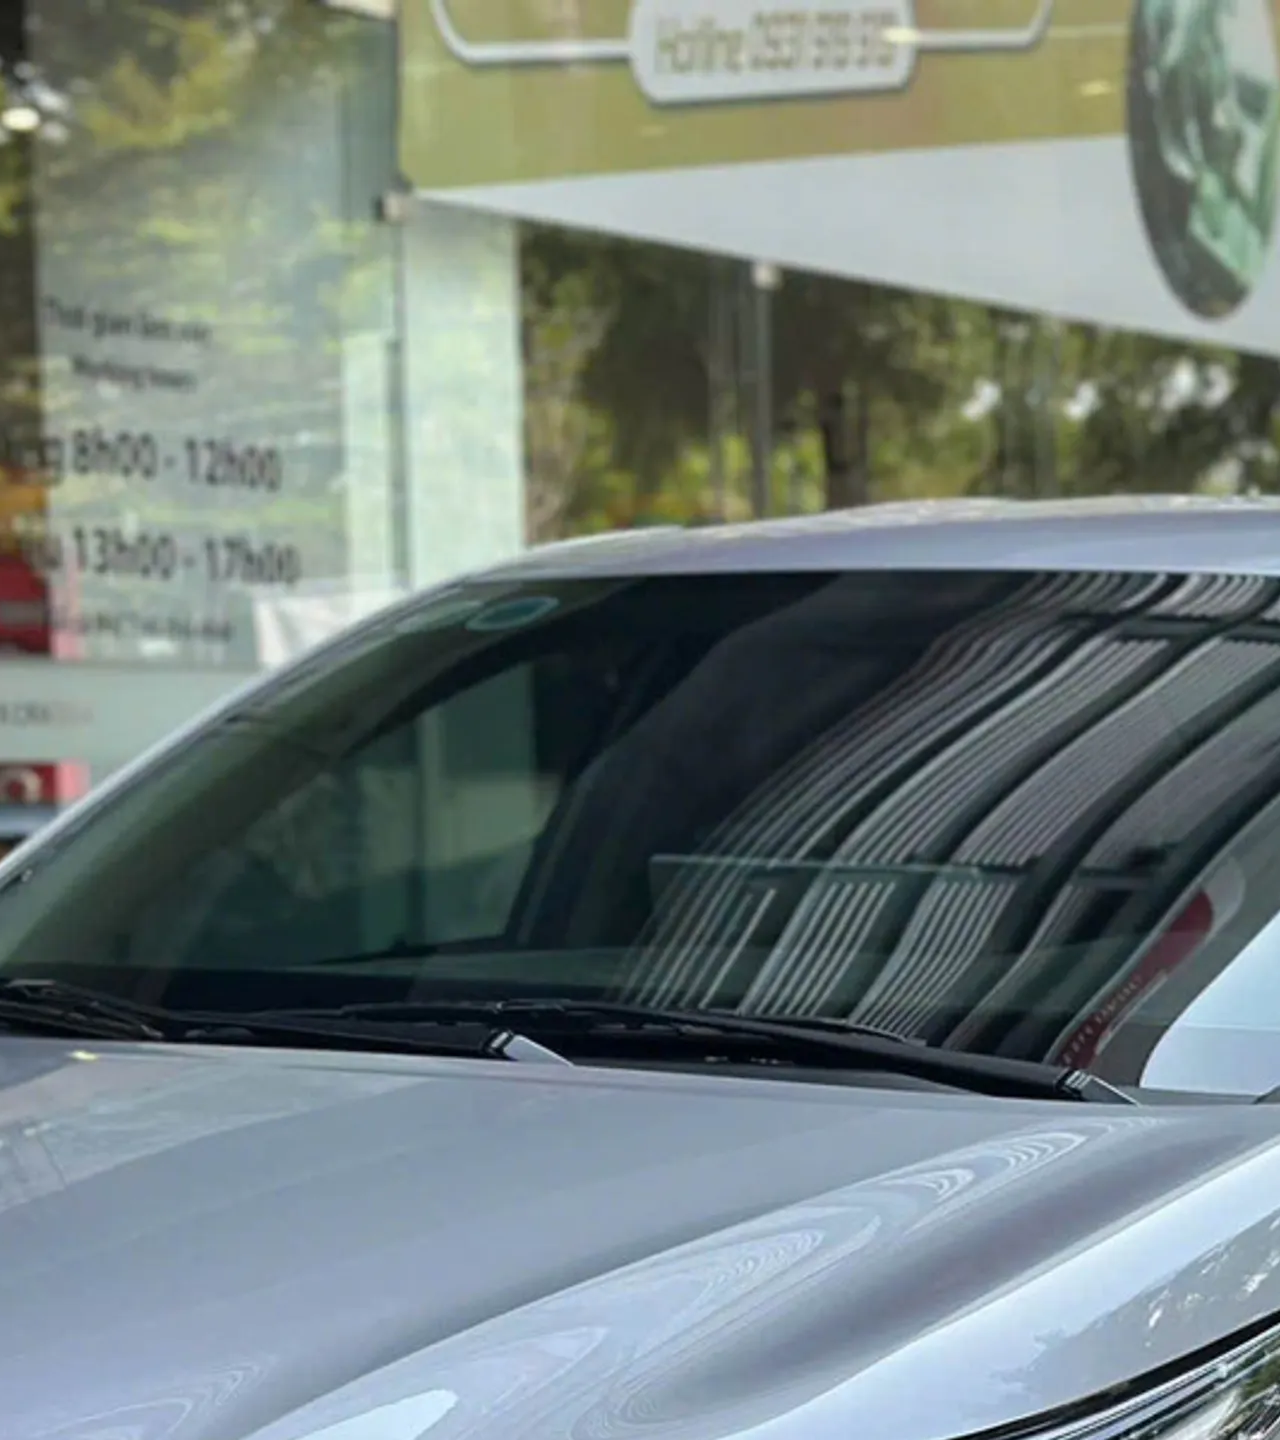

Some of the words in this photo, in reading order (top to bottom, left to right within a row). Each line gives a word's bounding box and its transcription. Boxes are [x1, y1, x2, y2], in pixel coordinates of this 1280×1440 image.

[73, 427, 159, 479] 8h00
[184, 434, 283, 494] 12h00
[72, 523, 178, 582] 13h00
[204, 532, 301, 592] 17h00
